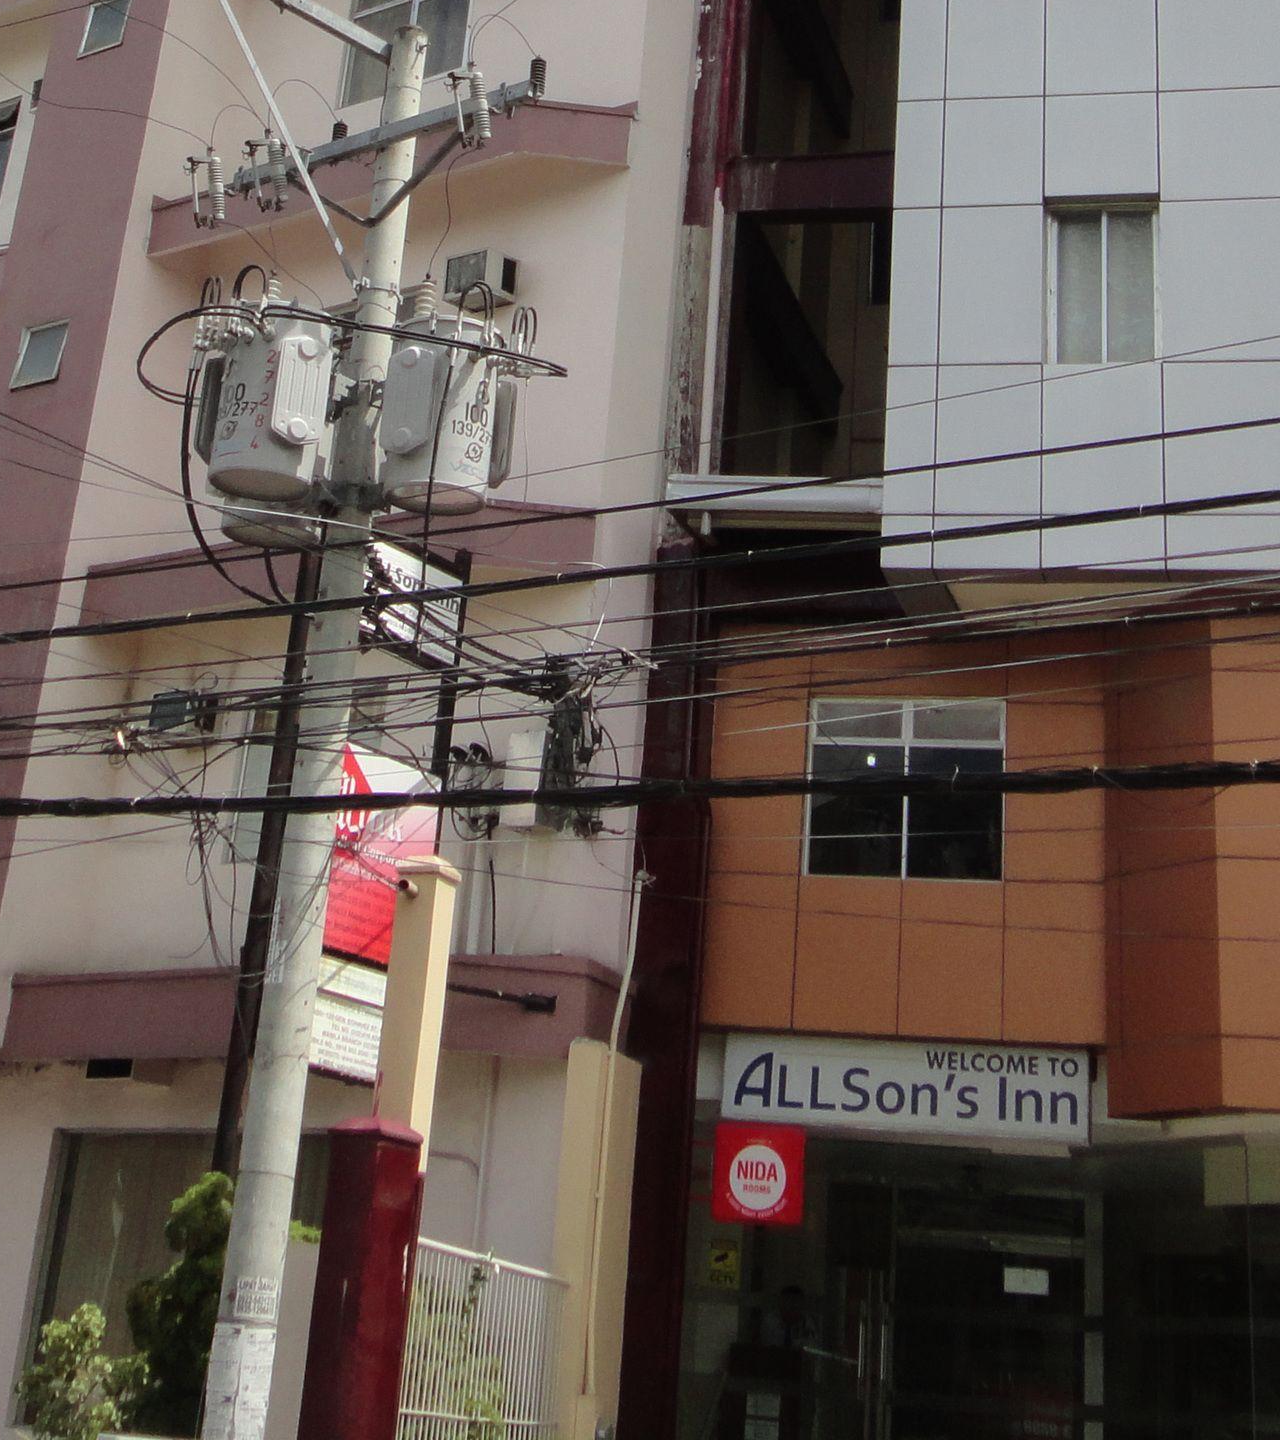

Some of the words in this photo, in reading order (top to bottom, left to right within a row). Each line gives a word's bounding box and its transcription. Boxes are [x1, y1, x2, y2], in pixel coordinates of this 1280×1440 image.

[465, 401, 489, 427] 100
[926, 1050, 1038, 1075] WELCOME
[1047, 1057, 1079, 1077] TO
[733, 1051, 979, 1120] ALLSon's
[997, 1076, 1078, 1126] Inn
[736, 1159, 779, 1183] NIDA
[742, 1183, 771, 1195] ROOMS
